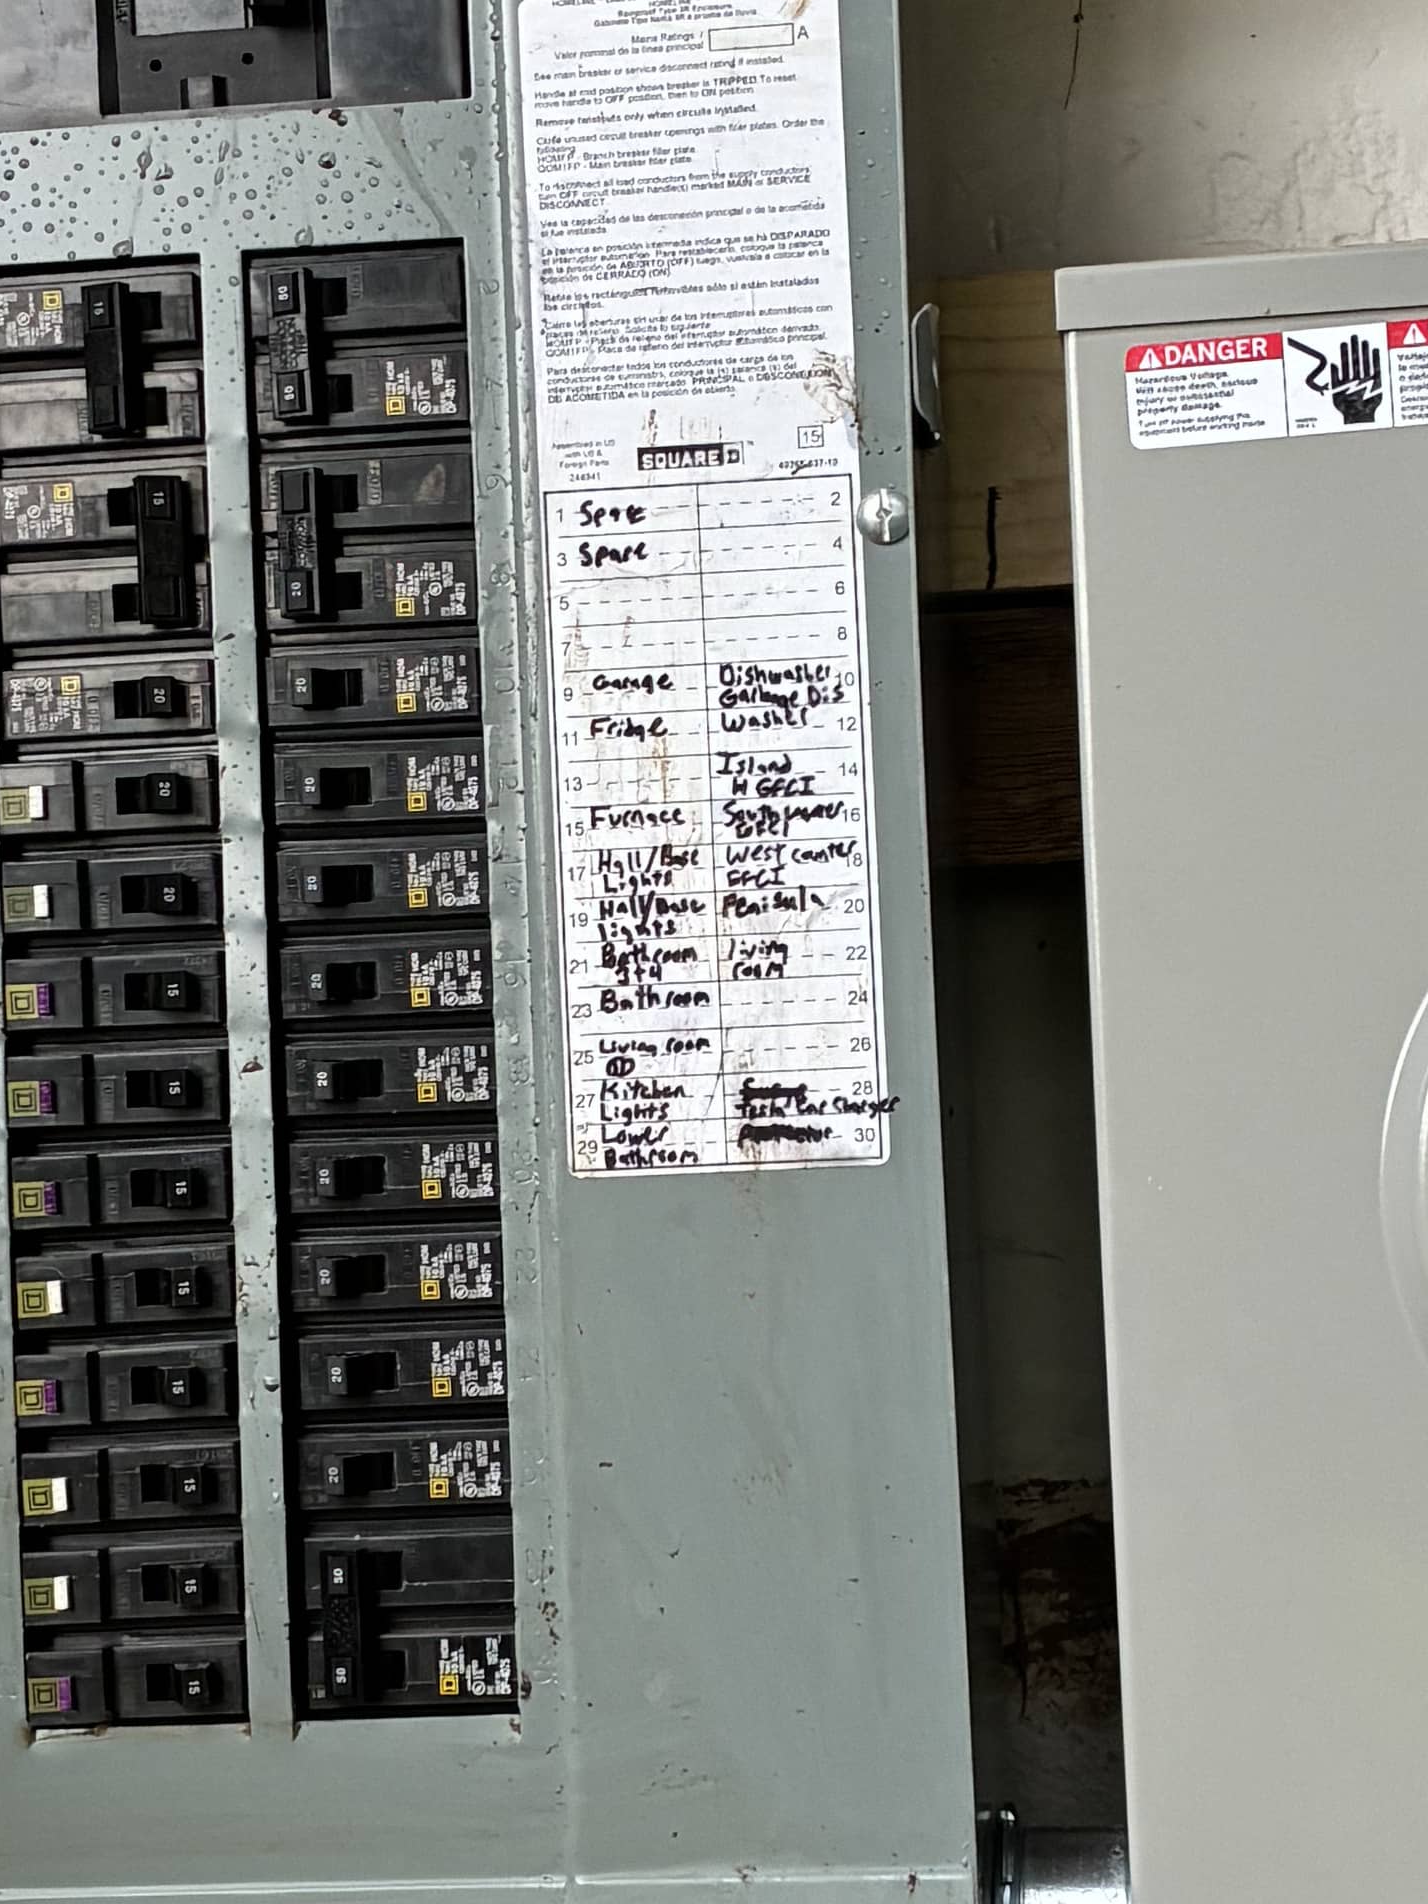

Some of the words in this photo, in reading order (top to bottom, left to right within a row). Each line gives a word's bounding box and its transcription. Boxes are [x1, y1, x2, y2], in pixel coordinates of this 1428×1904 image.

[797, 26, 809, 39] A
[1163, 337, 1268, 367] DANGER
[803, 430, 821, 444] 15
[640, 449, 721, 469] SQUARE
[725, 450, 741, 465] D
[830, 492, 841, 507] 2
[556, 508, 563, 523] 1
[832, 536, 843, 550] 4
[556, 552, 568, 567] 3
[834, 581, 845, 595] 6
[559, 596, 569, 611] 5
[837, 626, 848, 641] 8
[561, 642, 571, 656] 7
[719, 663, 831, 686] Dishwasher
[834, 671, 855, 687] 10
[563, 687, 574, 702] 9
[807, 684, 845, 708] Dis
[589, 716, 668, 743] Fridge
[836, 716, 857, 731] 12
[562, 731, 578, 746] 11
[714, 751, 793, 775] Island
[838, 761, 858, 777] 14
[564, 776, 582, 792] 13
[755, 775, 816, 798] GFCI
[842, 807, 861, 823] 16
[565, 822, 584, 837] 15
[726, 844, 787, 866] West
[845, 852, 863, 868] 18
[568, 865, 586, 881] 17
[843, 898, 865, 915] 20
[569, 911, 589, 928] 19
[845, 945, 868, 961] 22
[569, 958, 588, 974] 21
[847, 990, 869, 1005] 24
[571, 1003, 592, 1019] 23
[850, 1037, 871, 1052] 26
[573, 1050, 595, 1066] 25
[599, 1079, 687, 1101] Kitchen
[851, 1081, 874, 1096] 28
[575, 1093, 596, 1109] 27
[600, 1102, 670, 1126] Lights
[600, 1123, 670, 1147] Lower
[853, 1127, 876, 1143] 30
[577, 1139, 598, 1155] 29
[604, 1146, 699, 1169] Bathroom
